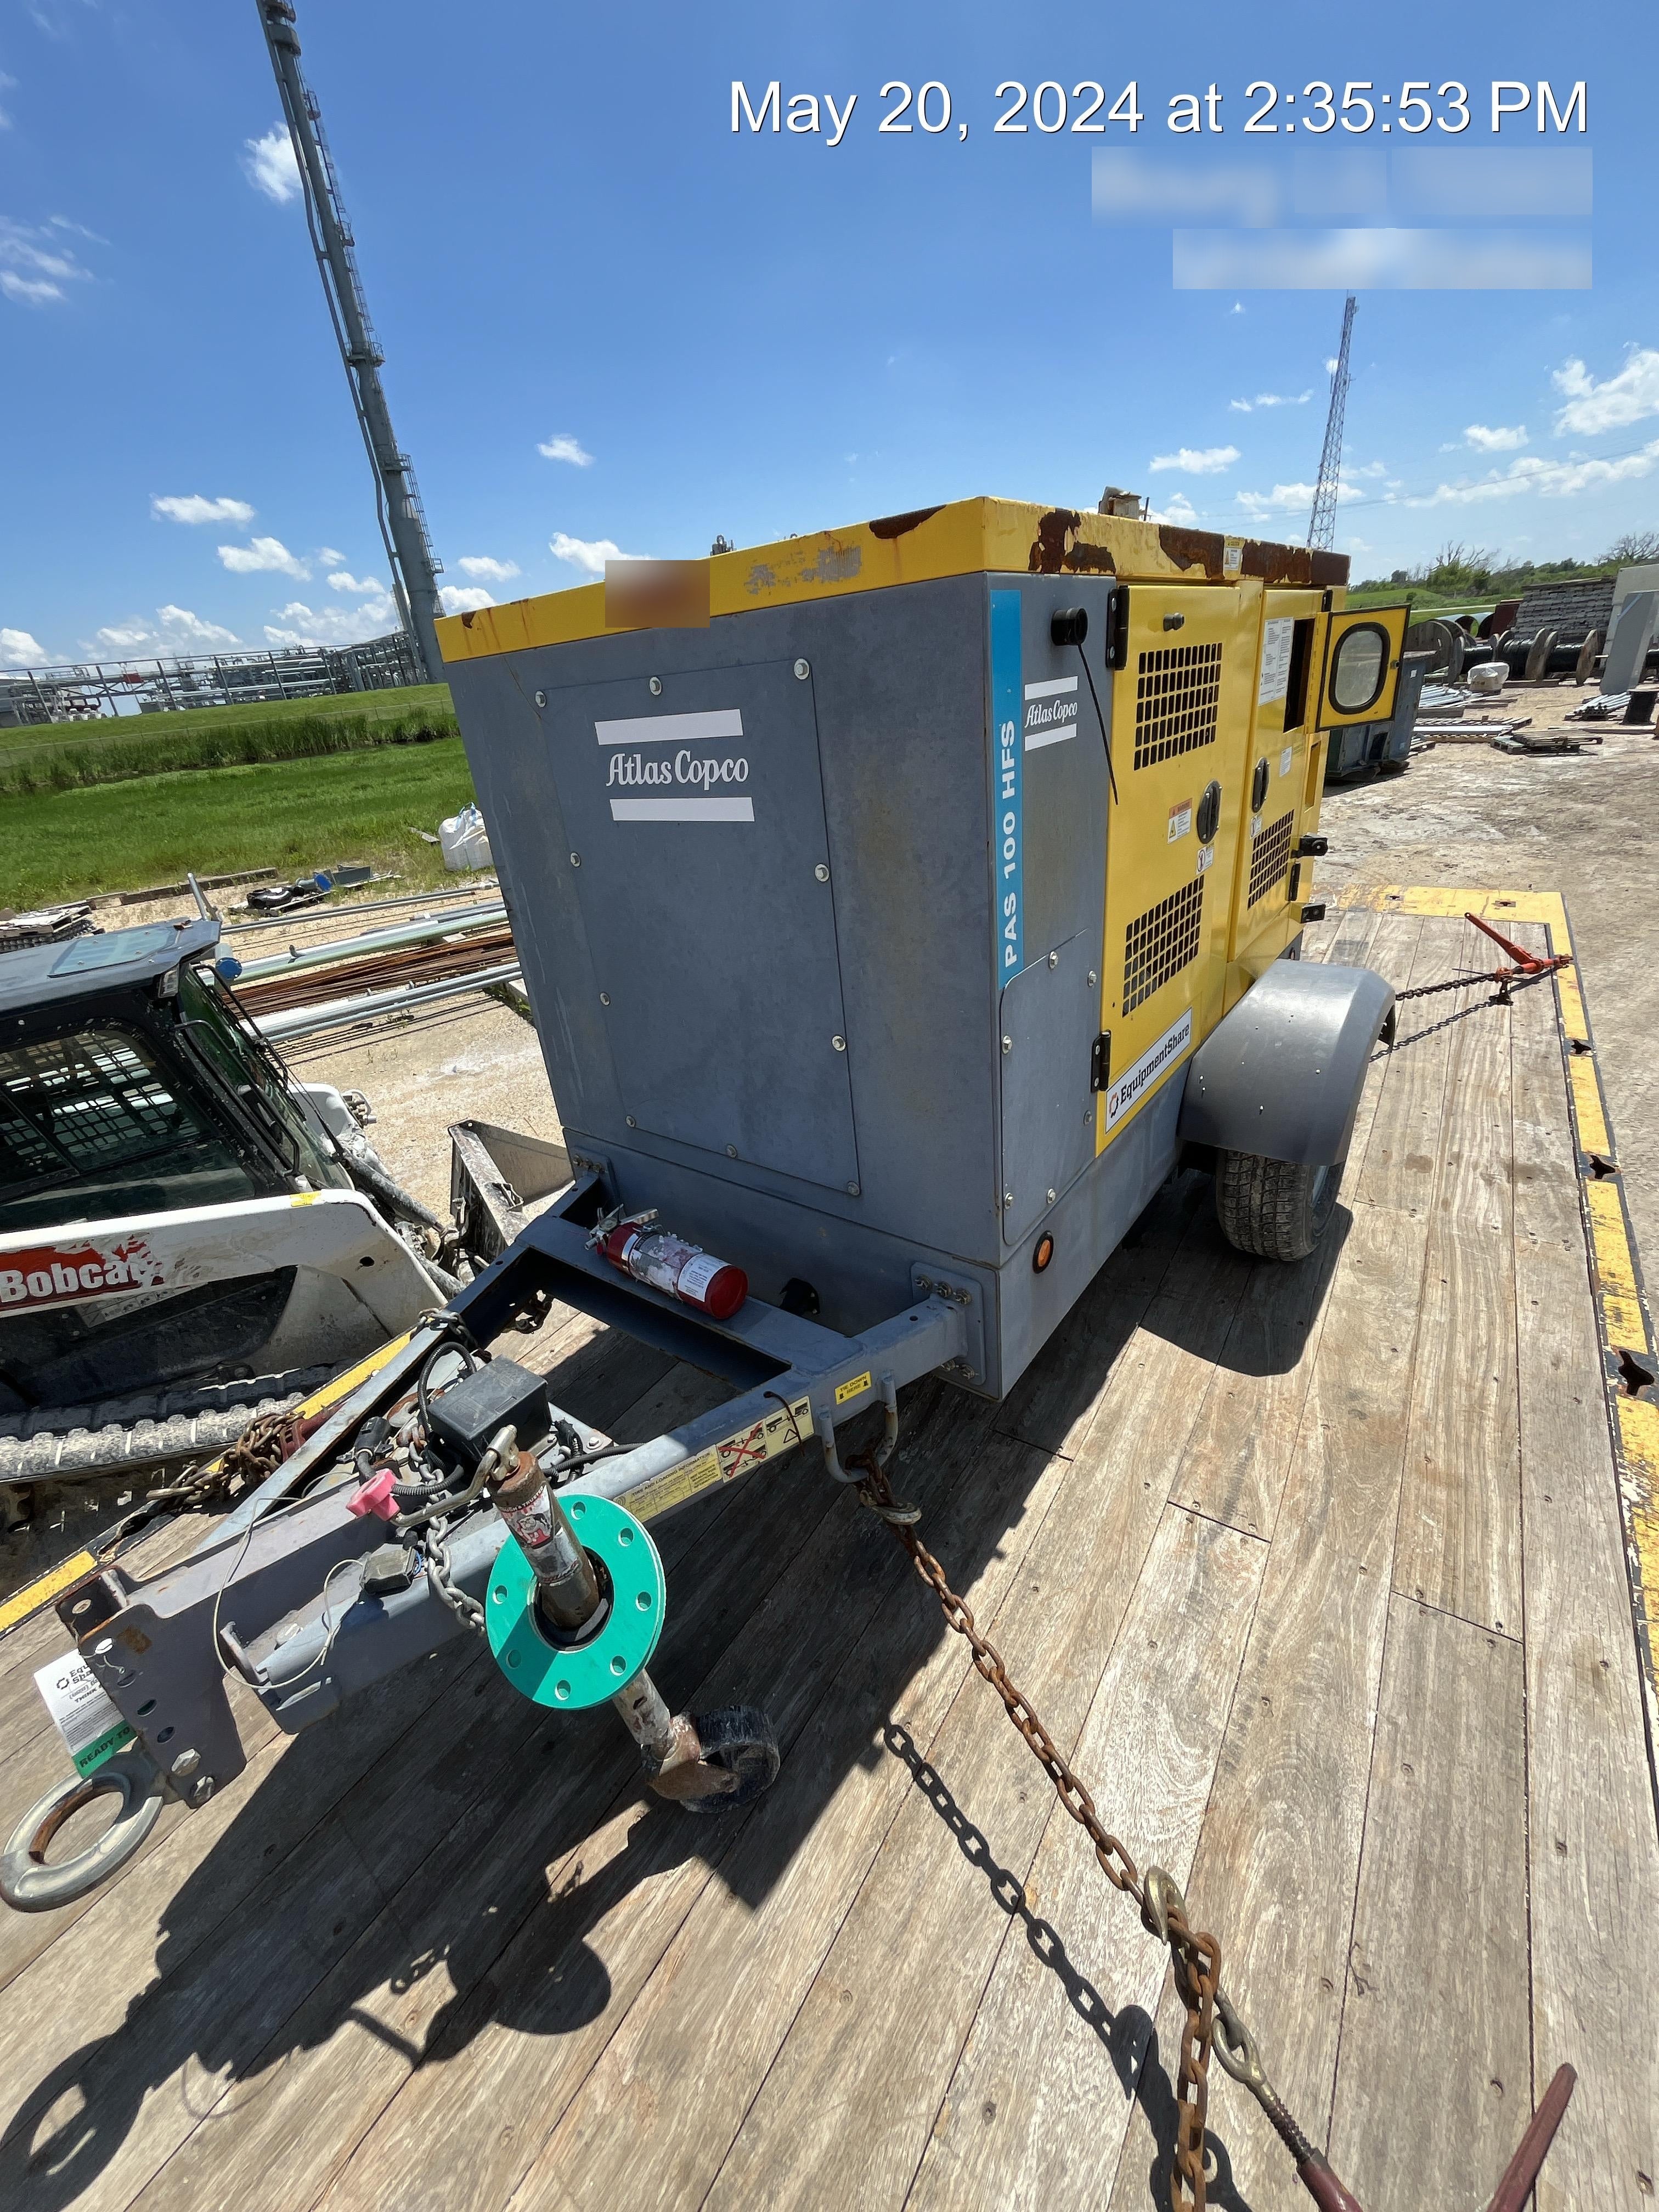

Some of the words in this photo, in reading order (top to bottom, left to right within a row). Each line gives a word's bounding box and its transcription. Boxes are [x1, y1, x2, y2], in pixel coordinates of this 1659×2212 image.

[1024, 703, 1053, 729] Atlas
[1053, 699, 1078, 723] Copco
[605, 753, 672, 787] Atlas
[674, 749, 749, 791] Copco
[1001, 720, 1015, 800] HFS
[1003, 811, 1017, 879] 100
[1004, 891, 1018, 968] PAS
[1120, 1023, 1190, 1105] EquipmentShare
[847, 1384, 861, 1394] HERE
[849, 1375, 867, 1387] DOWN
[645, 1482, 655, 1491] AND
[656, 1470, 678, 1484] LOADING
[679, 1452, 711, 1471] INFORMATION
[79, 1737, 115, 1768] READY
[116, 1725, 131, 1739] TO
